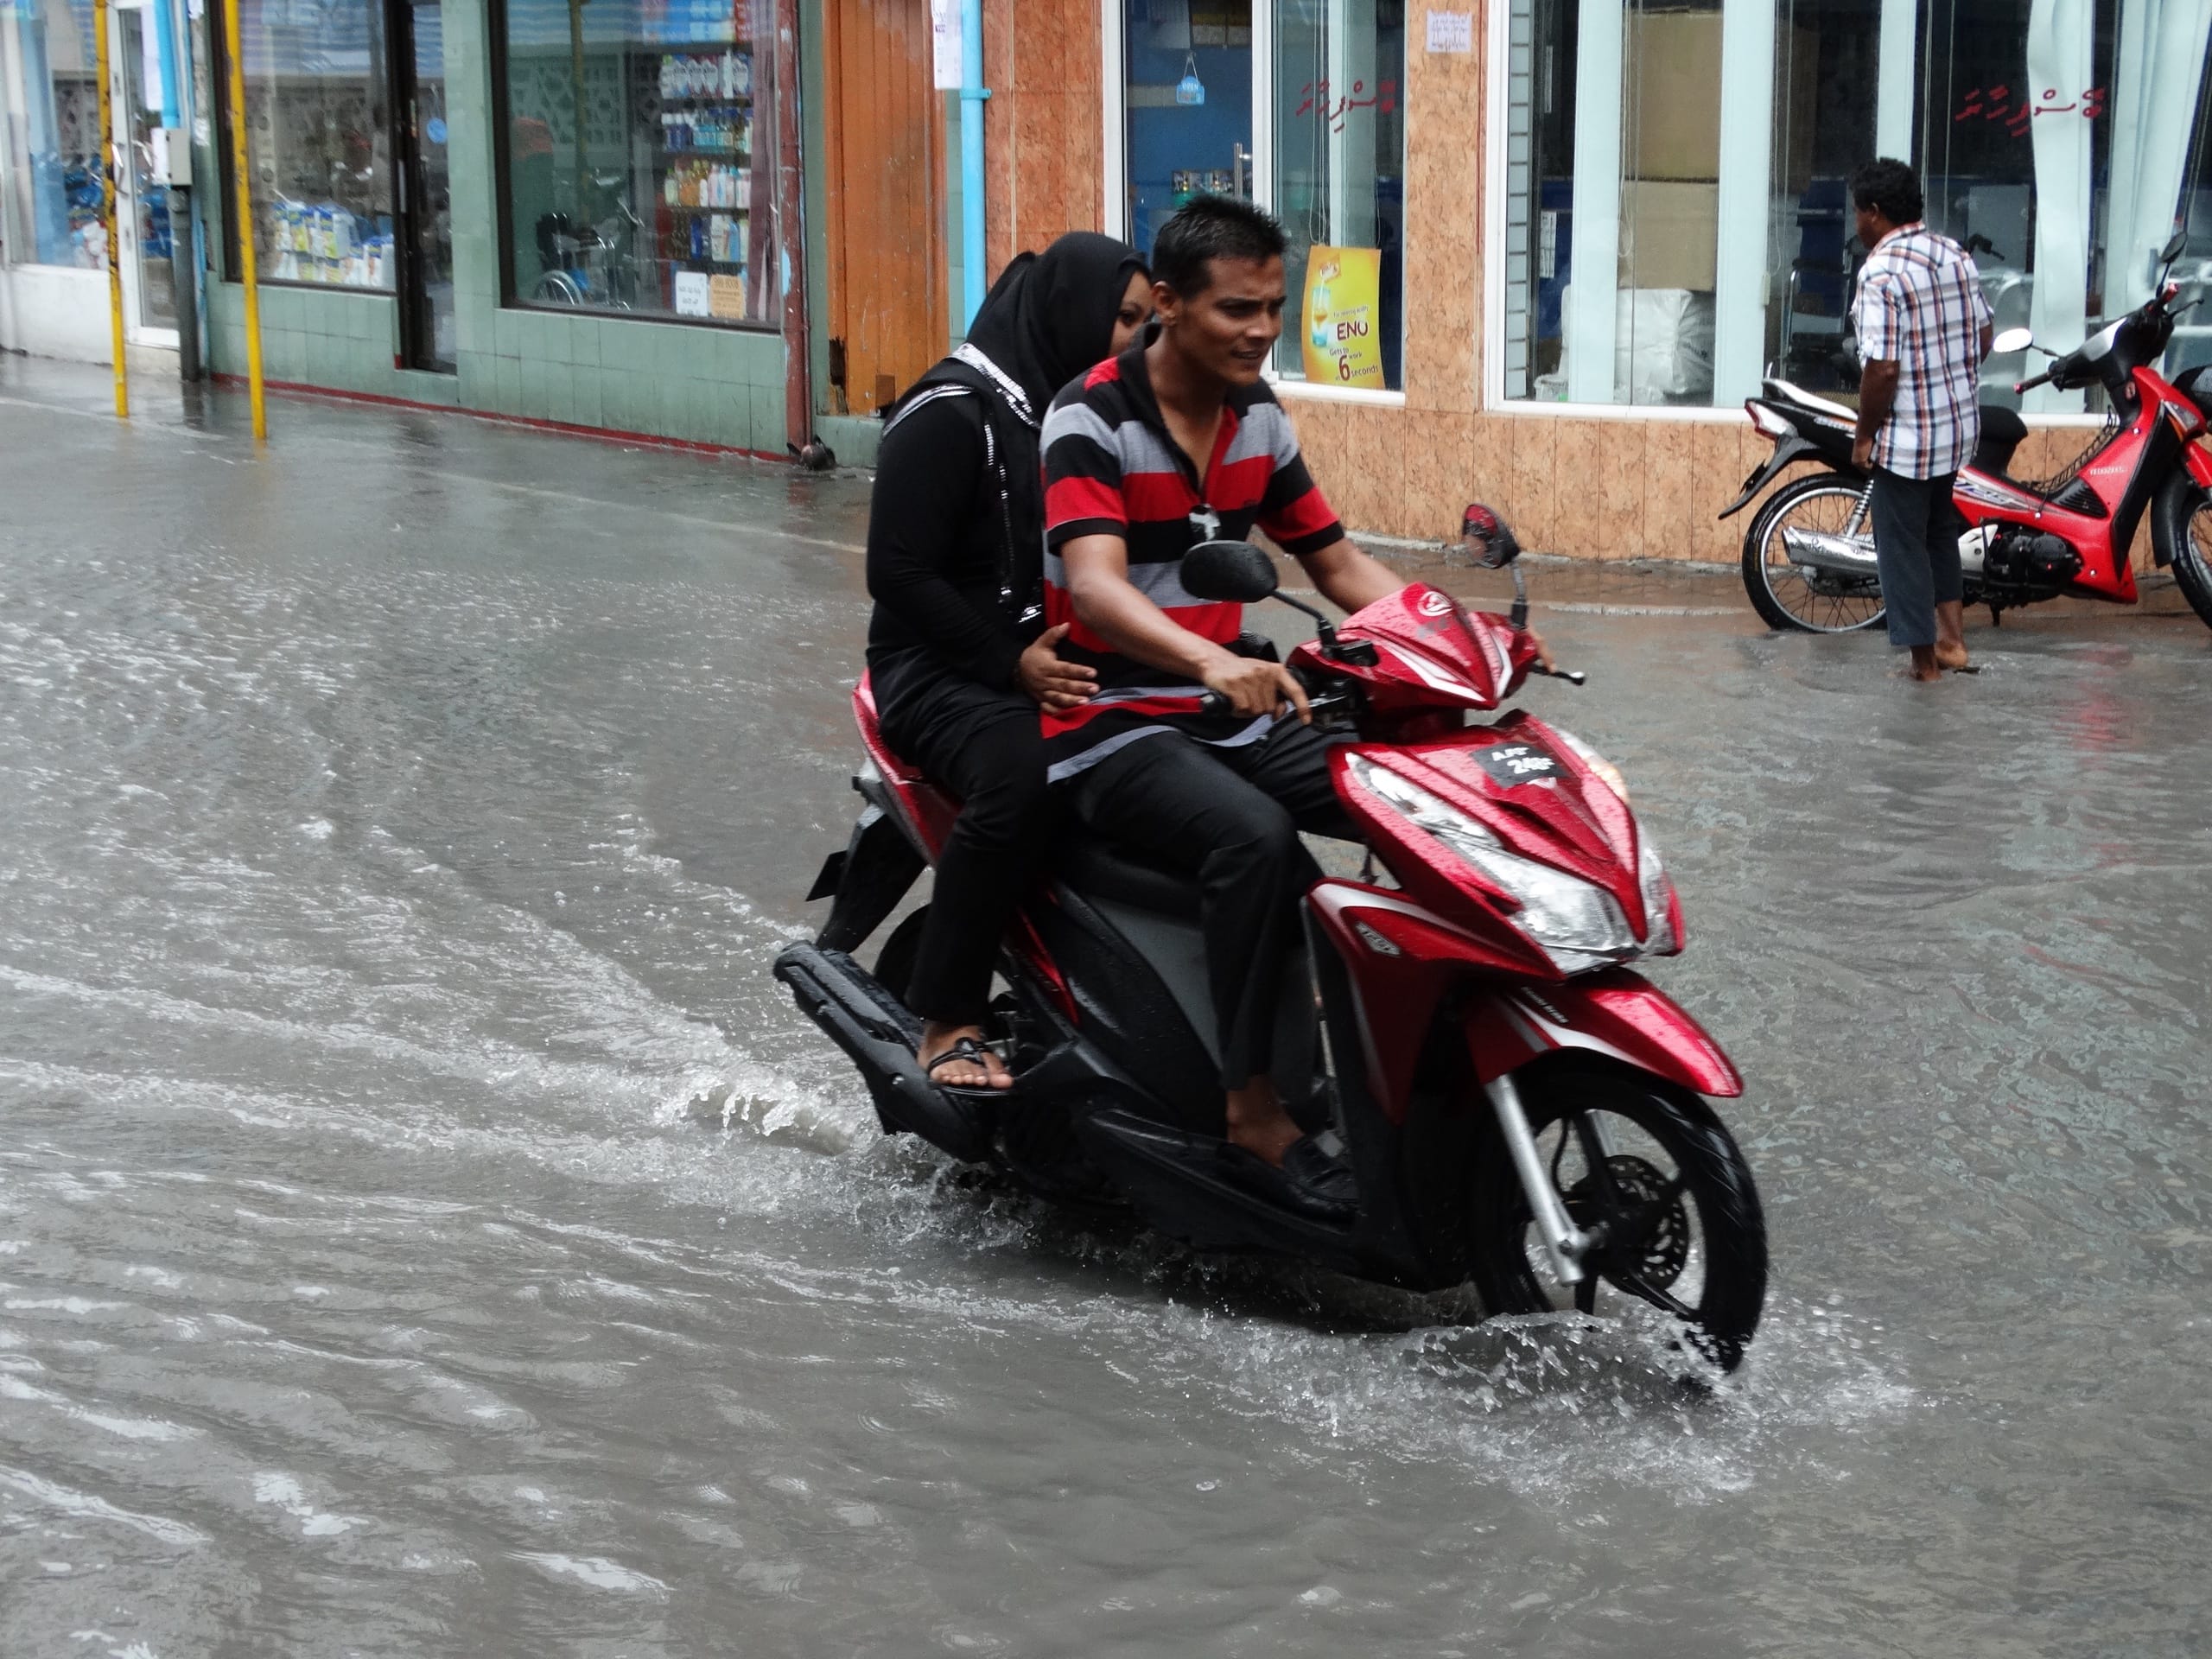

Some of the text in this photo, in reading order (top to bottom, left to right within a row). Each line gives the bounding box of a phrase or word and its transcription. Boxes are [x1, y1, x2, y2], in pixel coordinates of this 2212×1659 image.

[1329, 347, 1342, 356] Gets
[1349, 350, 1363, 359] work
[1338, 354, 1351, 382] 6
[1351, 364, 1380, 378] seconds
